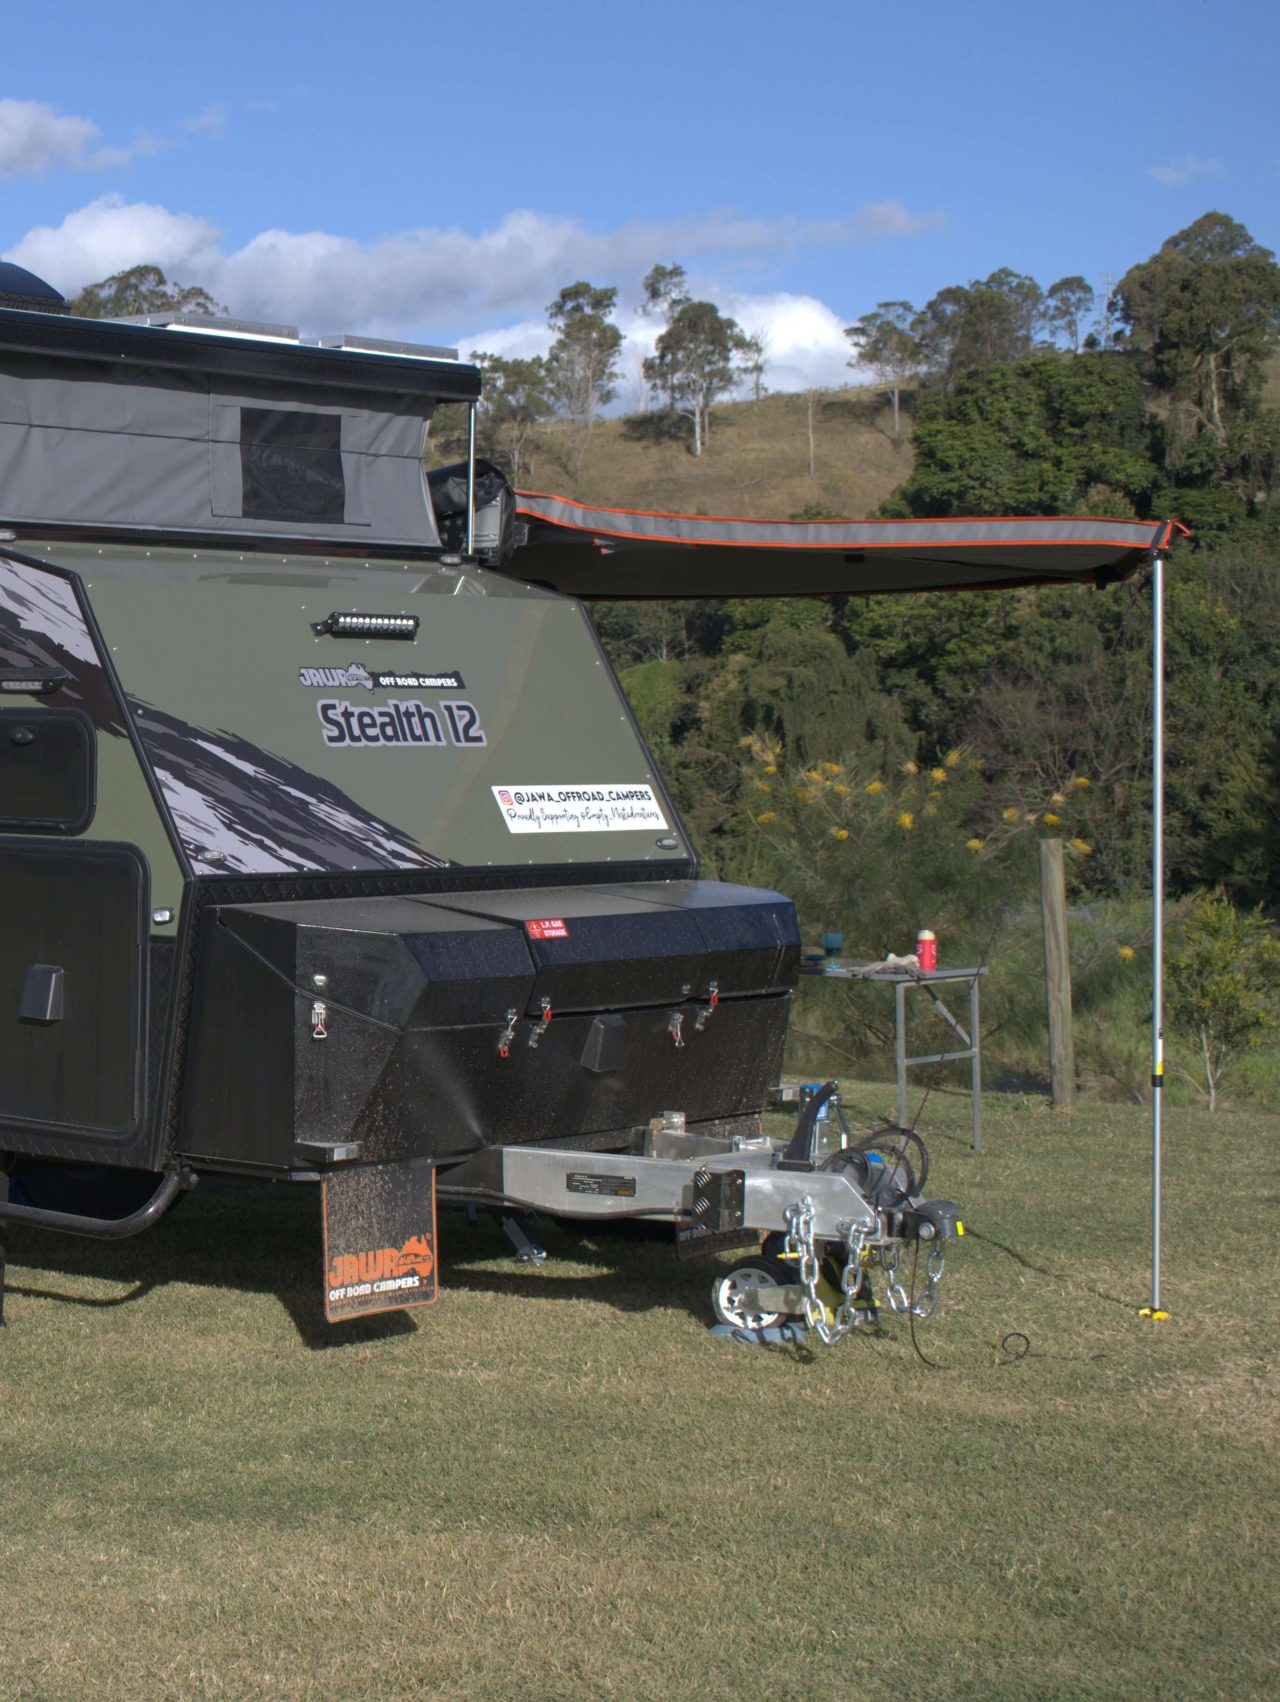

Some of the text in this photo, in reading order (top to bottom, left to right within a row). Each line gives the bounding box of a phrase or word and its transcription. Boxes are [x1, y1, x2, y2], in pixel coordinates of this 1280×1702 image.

[379, 677, 458, 687] OFF ROAD CAMPERS
[320, 703, 484, 743] Stealth 12
[514, 790, 652, 805] @JAWA_OFFROAD_CAMPERS
[329, 1288, 346, 1301] OFF
[346, 1283, 371, 1298] ROAD
[373, 1275, 420, 1293] CAMPERS
